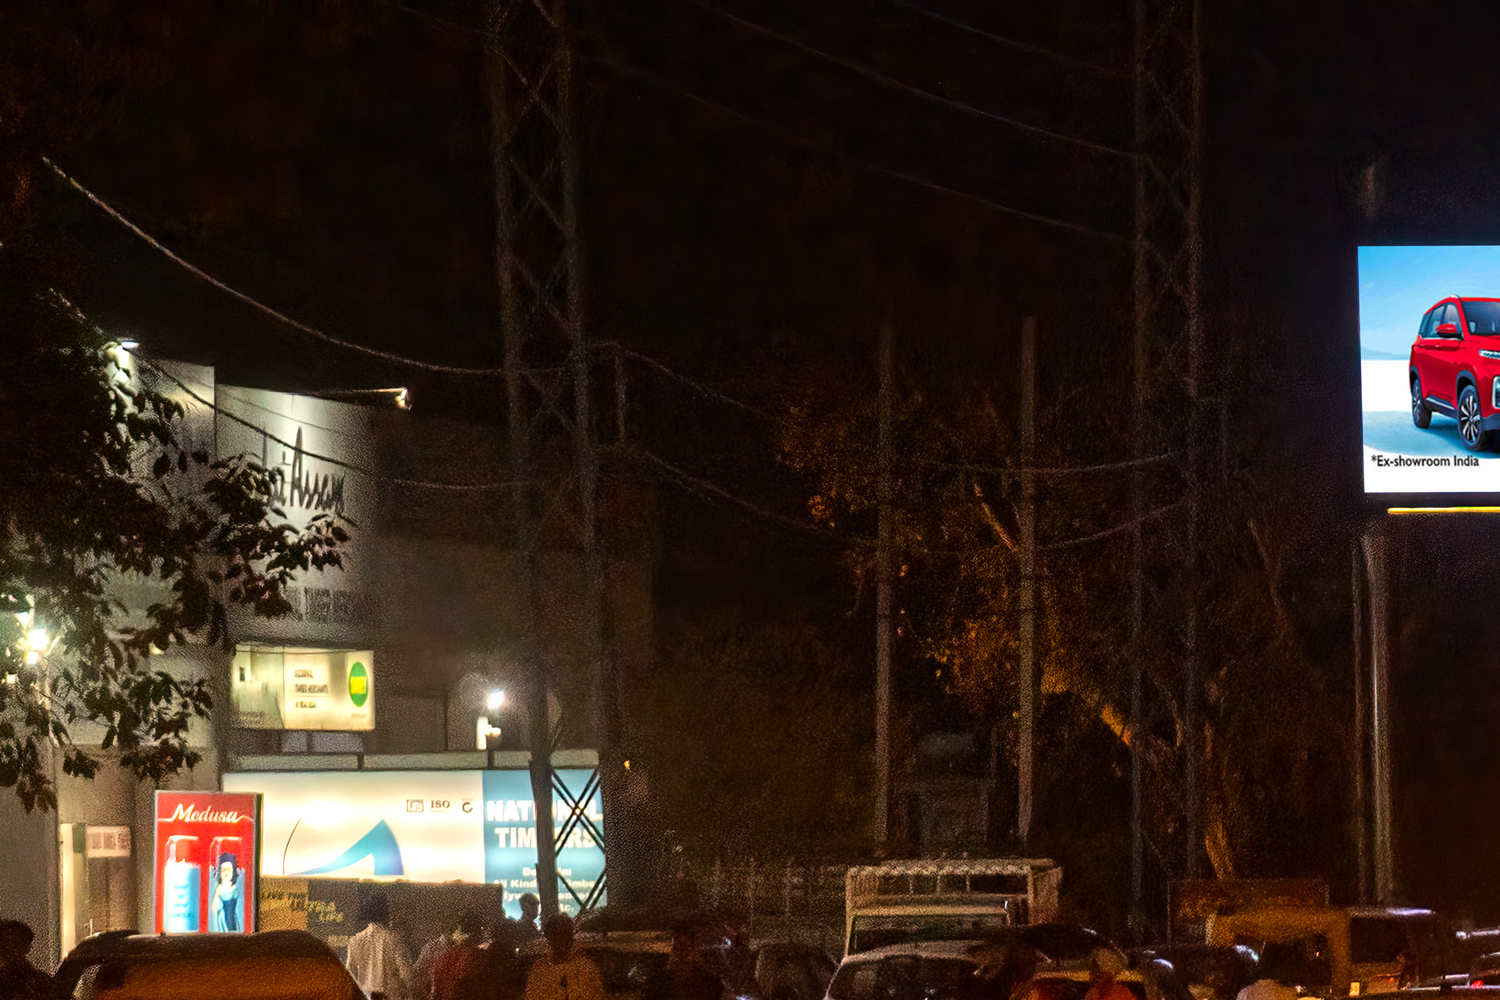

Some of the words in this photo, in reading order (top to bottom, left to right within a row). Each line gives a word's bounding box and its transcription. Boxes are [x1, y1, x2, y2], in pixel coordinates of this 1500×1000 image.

[1453, 455, 1480, 467] India
[431, 800, 450, 808] ISO
[168, 803, 245, 823] Medusa
